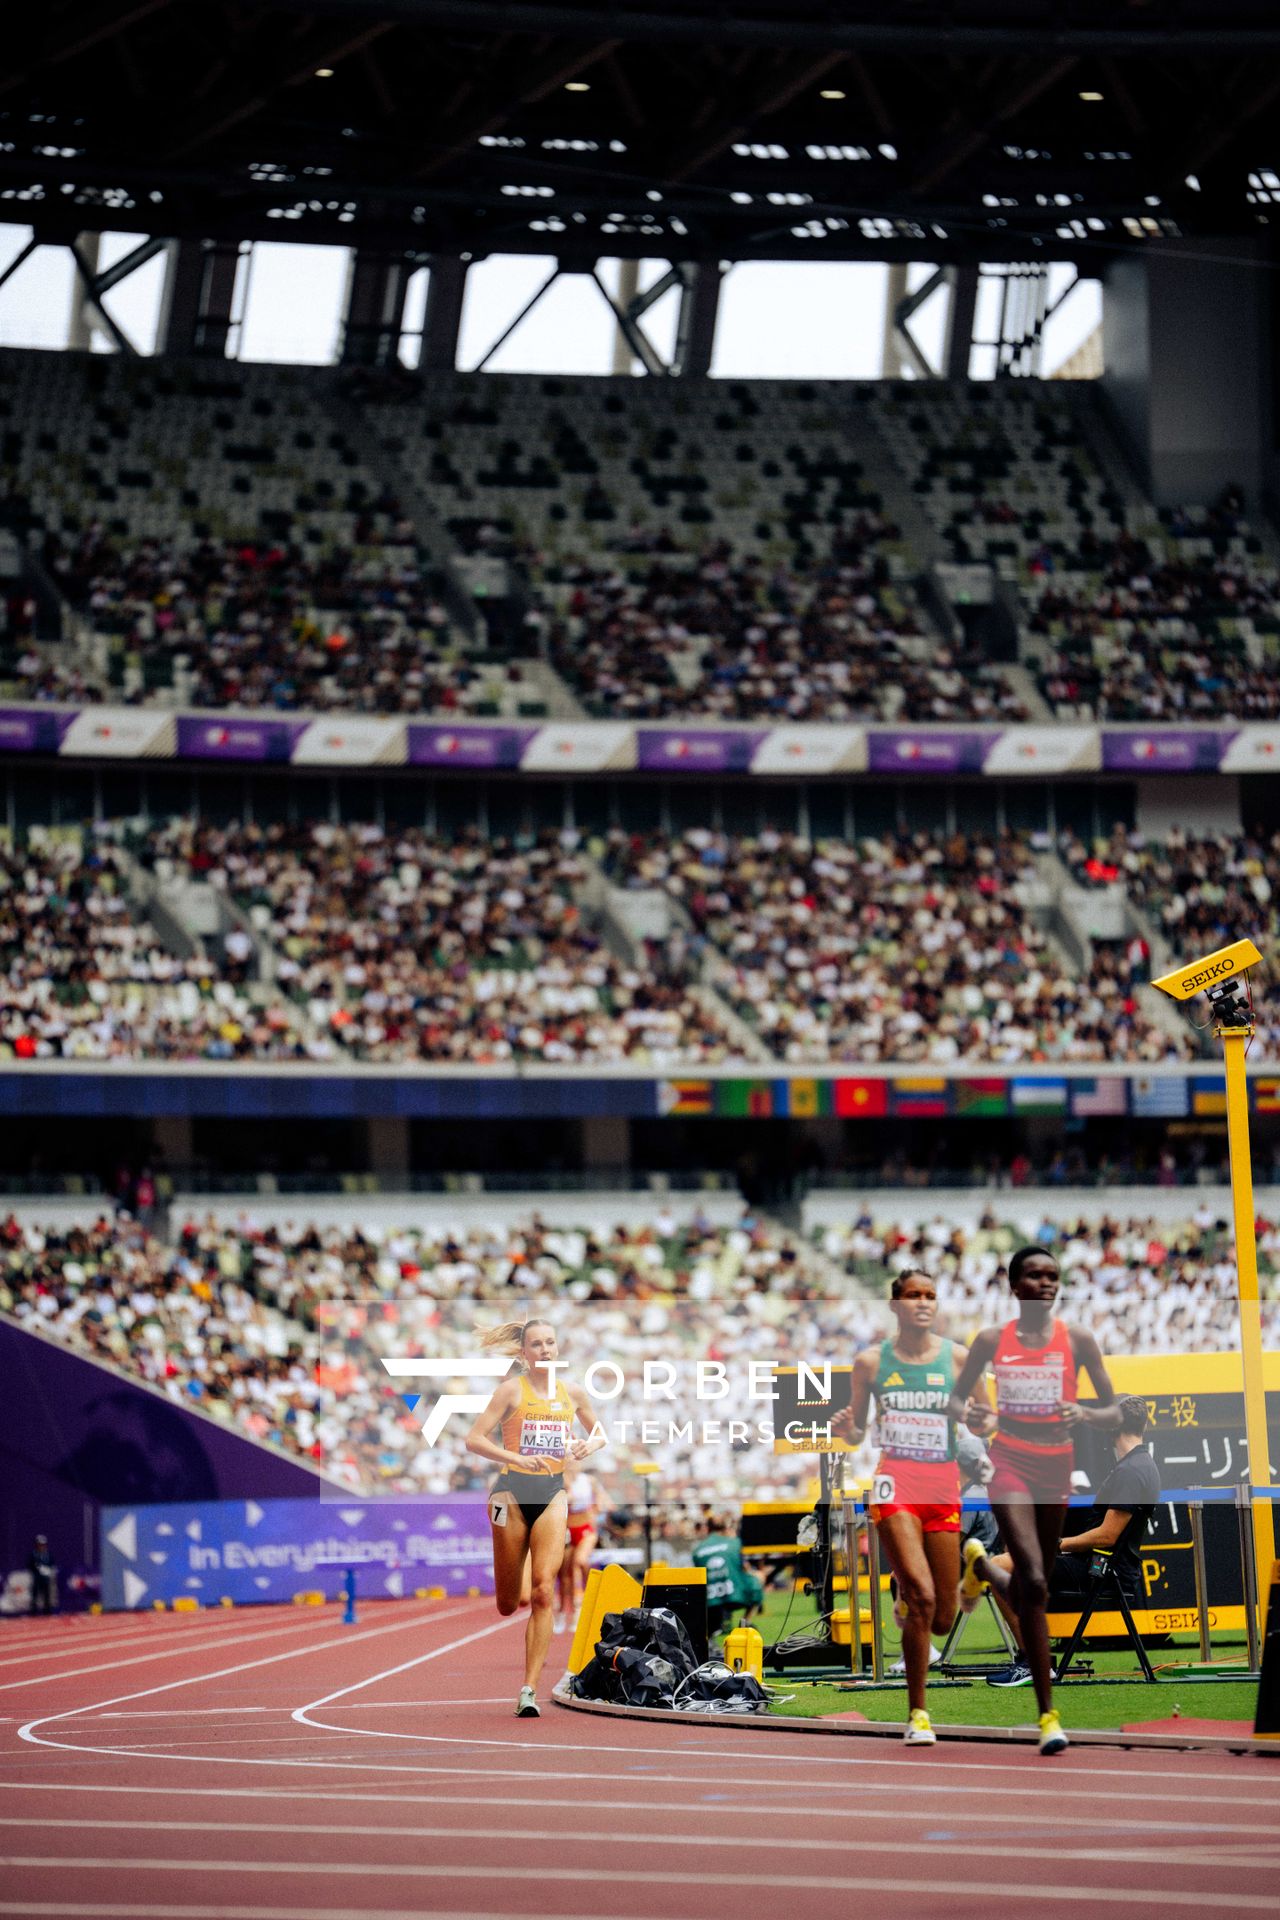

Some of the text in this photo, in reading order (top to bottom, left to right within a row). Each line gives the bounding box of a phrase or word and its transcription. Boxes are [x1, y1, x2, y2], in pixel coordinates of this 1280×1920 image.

[1181, 958, 1235, 992] SEIKO
[525, 1412, 570, 1421] GERMANY
[885, 1415, 945, 1427] HONDA
[792, 1440, 833, 1451] SEIKO
[885, 1429, 944, 1447] MULETA
[1148, 1437, 1278, 1479] ーリ
[494, 1505, 503, 1522] 7
[189, 1545, 219, 1569] In
[406, 1535, 494, 1563] Bette
[1153, 1612, 1218, 1630] SEIKO
